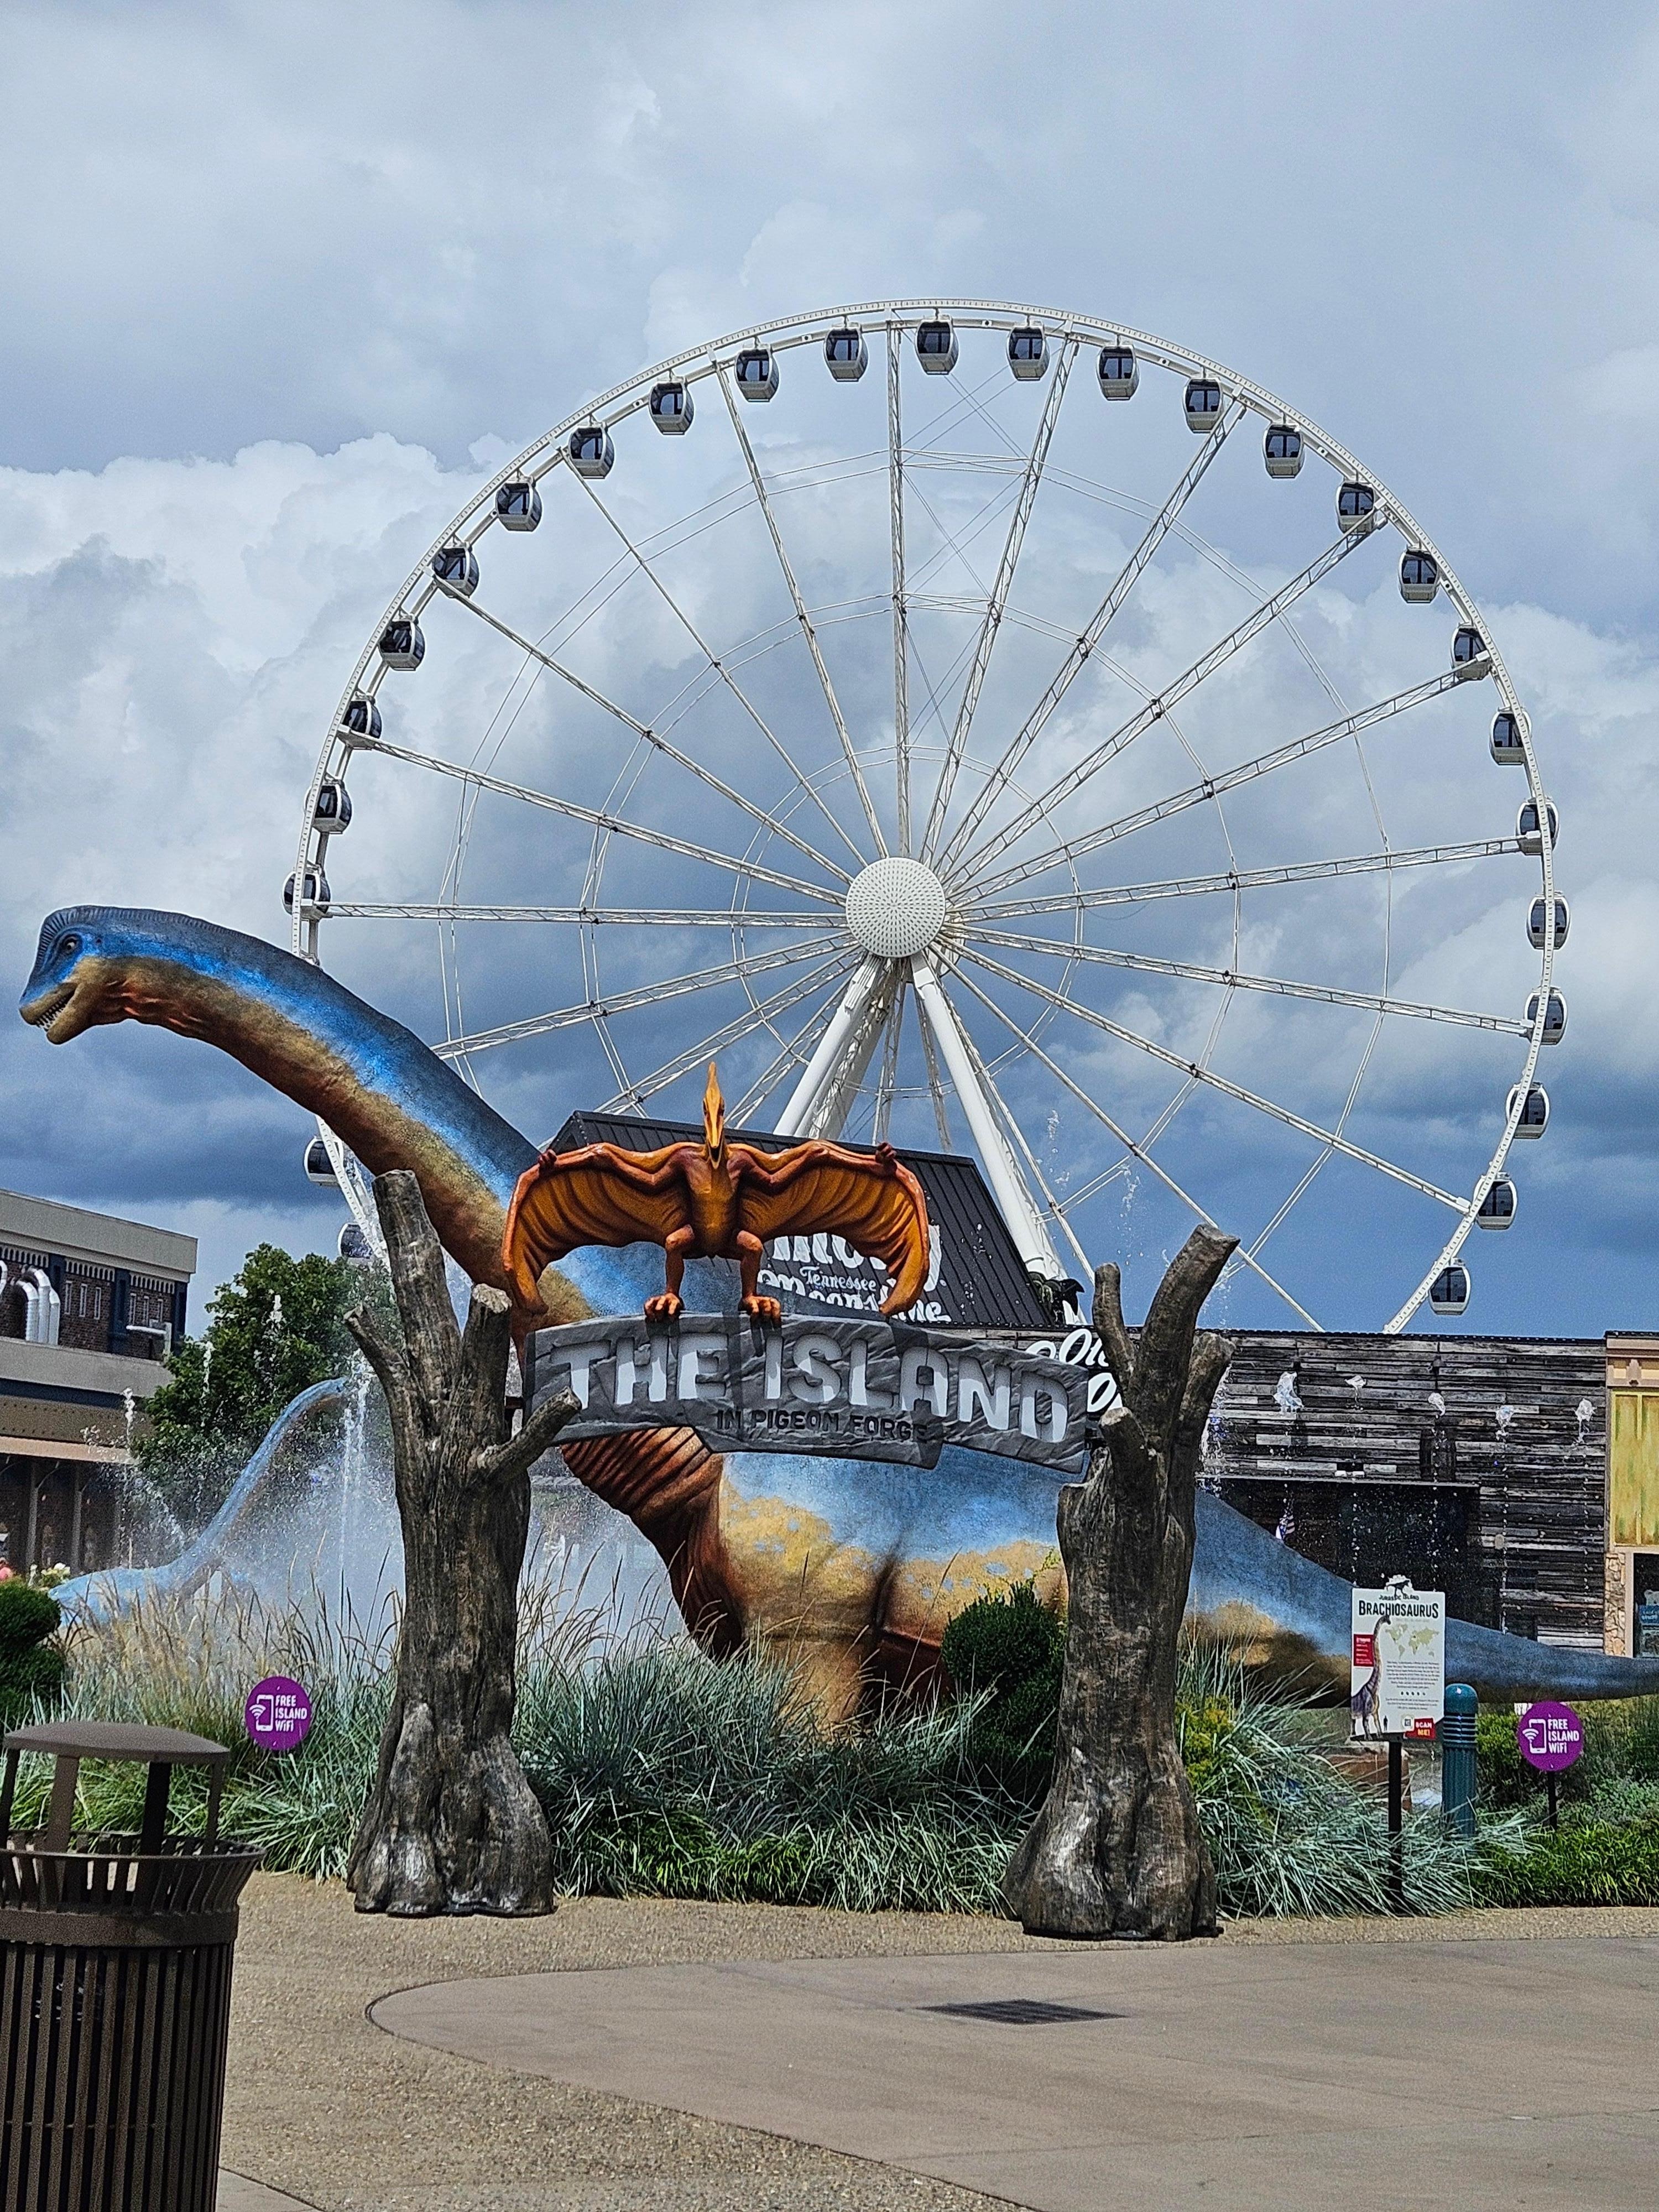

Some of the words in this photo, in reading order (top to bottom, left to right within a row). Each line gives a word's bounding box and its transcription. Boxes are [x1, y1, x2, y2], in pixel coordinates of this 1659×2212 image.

[800, 1265, 877, 1291] Tennessee
[551, 1332, 729, 1410] THE
[763, 1333, 1069, 1443] ISLAND
[718, 1410, 741, 1430] IN
[752, 1410, 839, 1432] PIGEON
[847, 1415, 928, 1442] FORGE
[1358, 1600, 1439, 1619] BRACHIOSAURUS
[275, 1694, 296, 1707] FREE
[275, 1707, 307, 1720] ISLAND
[1547, 1719, 1568, 1730] FREE
[1548, 1730, 1580, 1741] ISLAND
